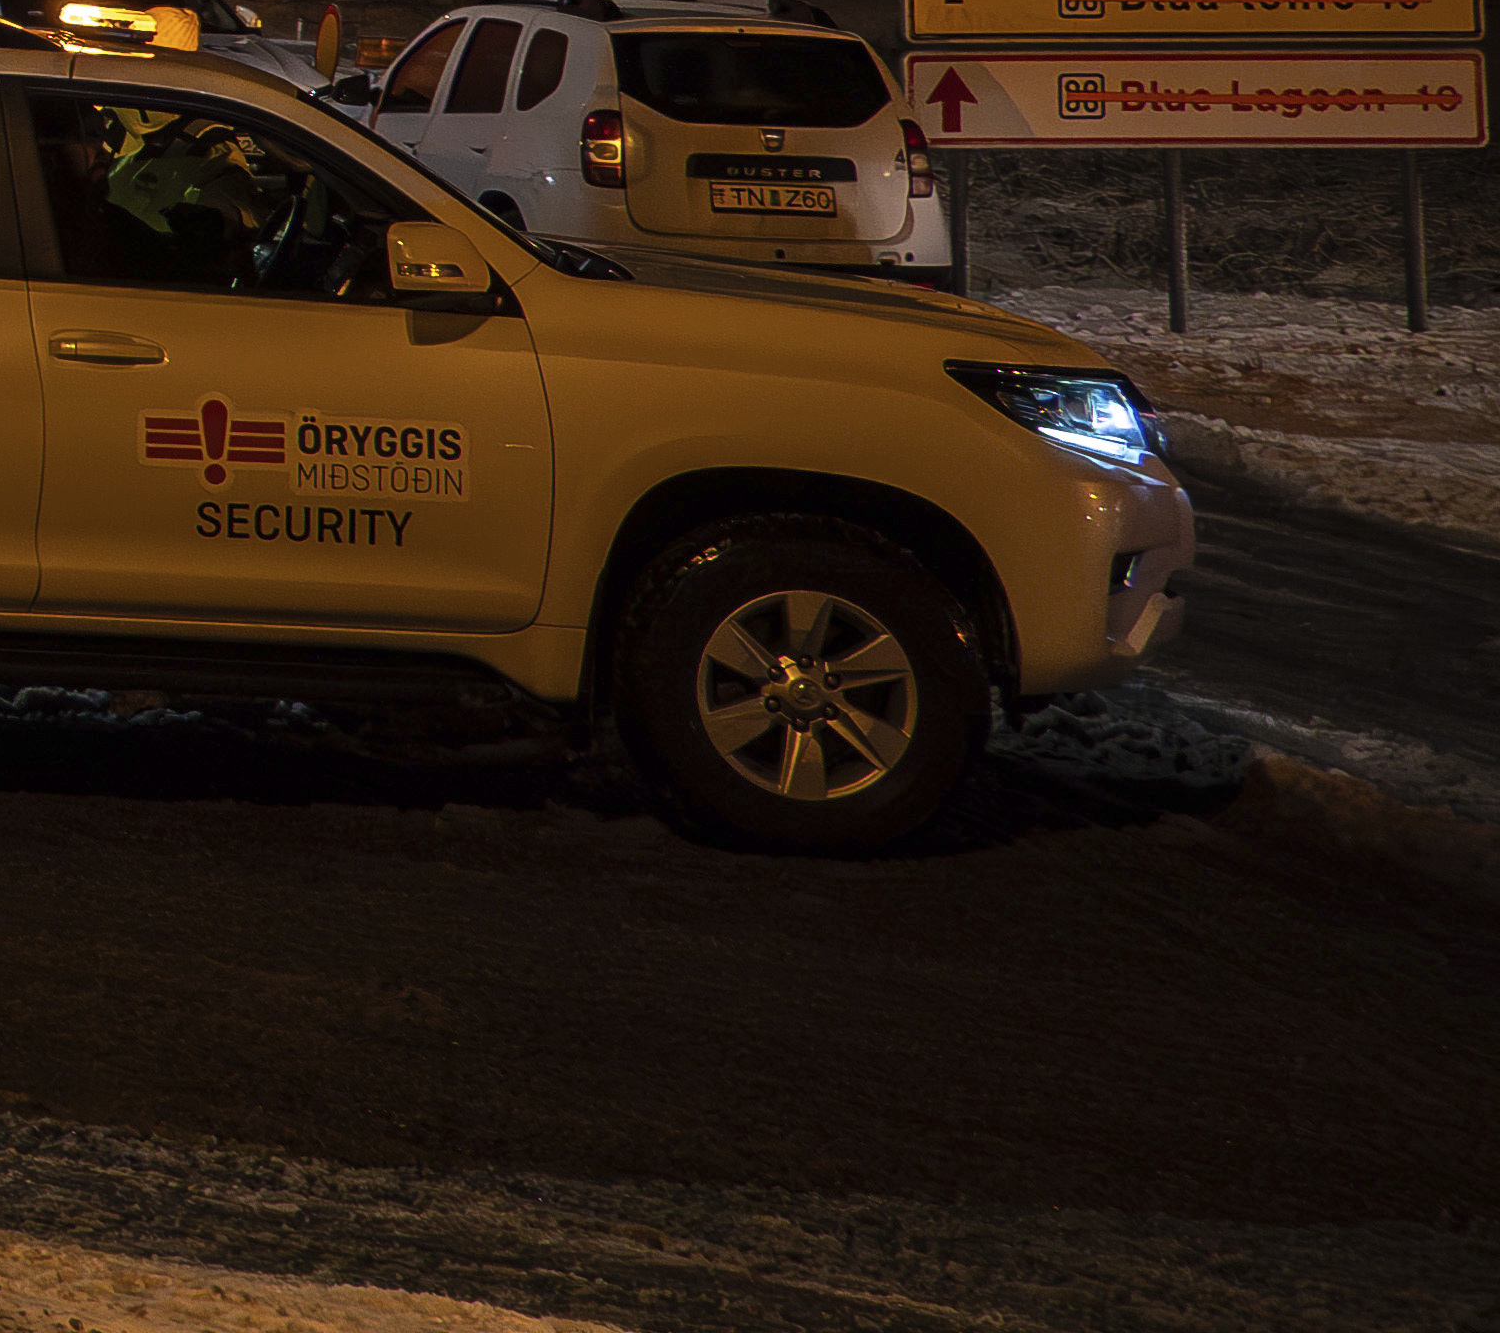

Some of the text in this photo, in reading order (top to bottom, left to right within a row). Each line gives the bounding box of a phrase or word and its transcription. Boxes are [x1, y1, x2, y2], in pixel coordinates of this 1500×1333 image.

[1120, 80, 1212, 112] Blue
[1230, 80, 1386, 118] Lagoon
[726, 166, 823, 179] DUSTER
[730, 187, 766, 206] TN
[785, 189, 831, 209] Z60
[296, 415, 463, 461] ÖRYGGIS
[296, 461, 464, 497] MIÐSTÖÐIN
[195, 500, 414, 547] SECURITY
